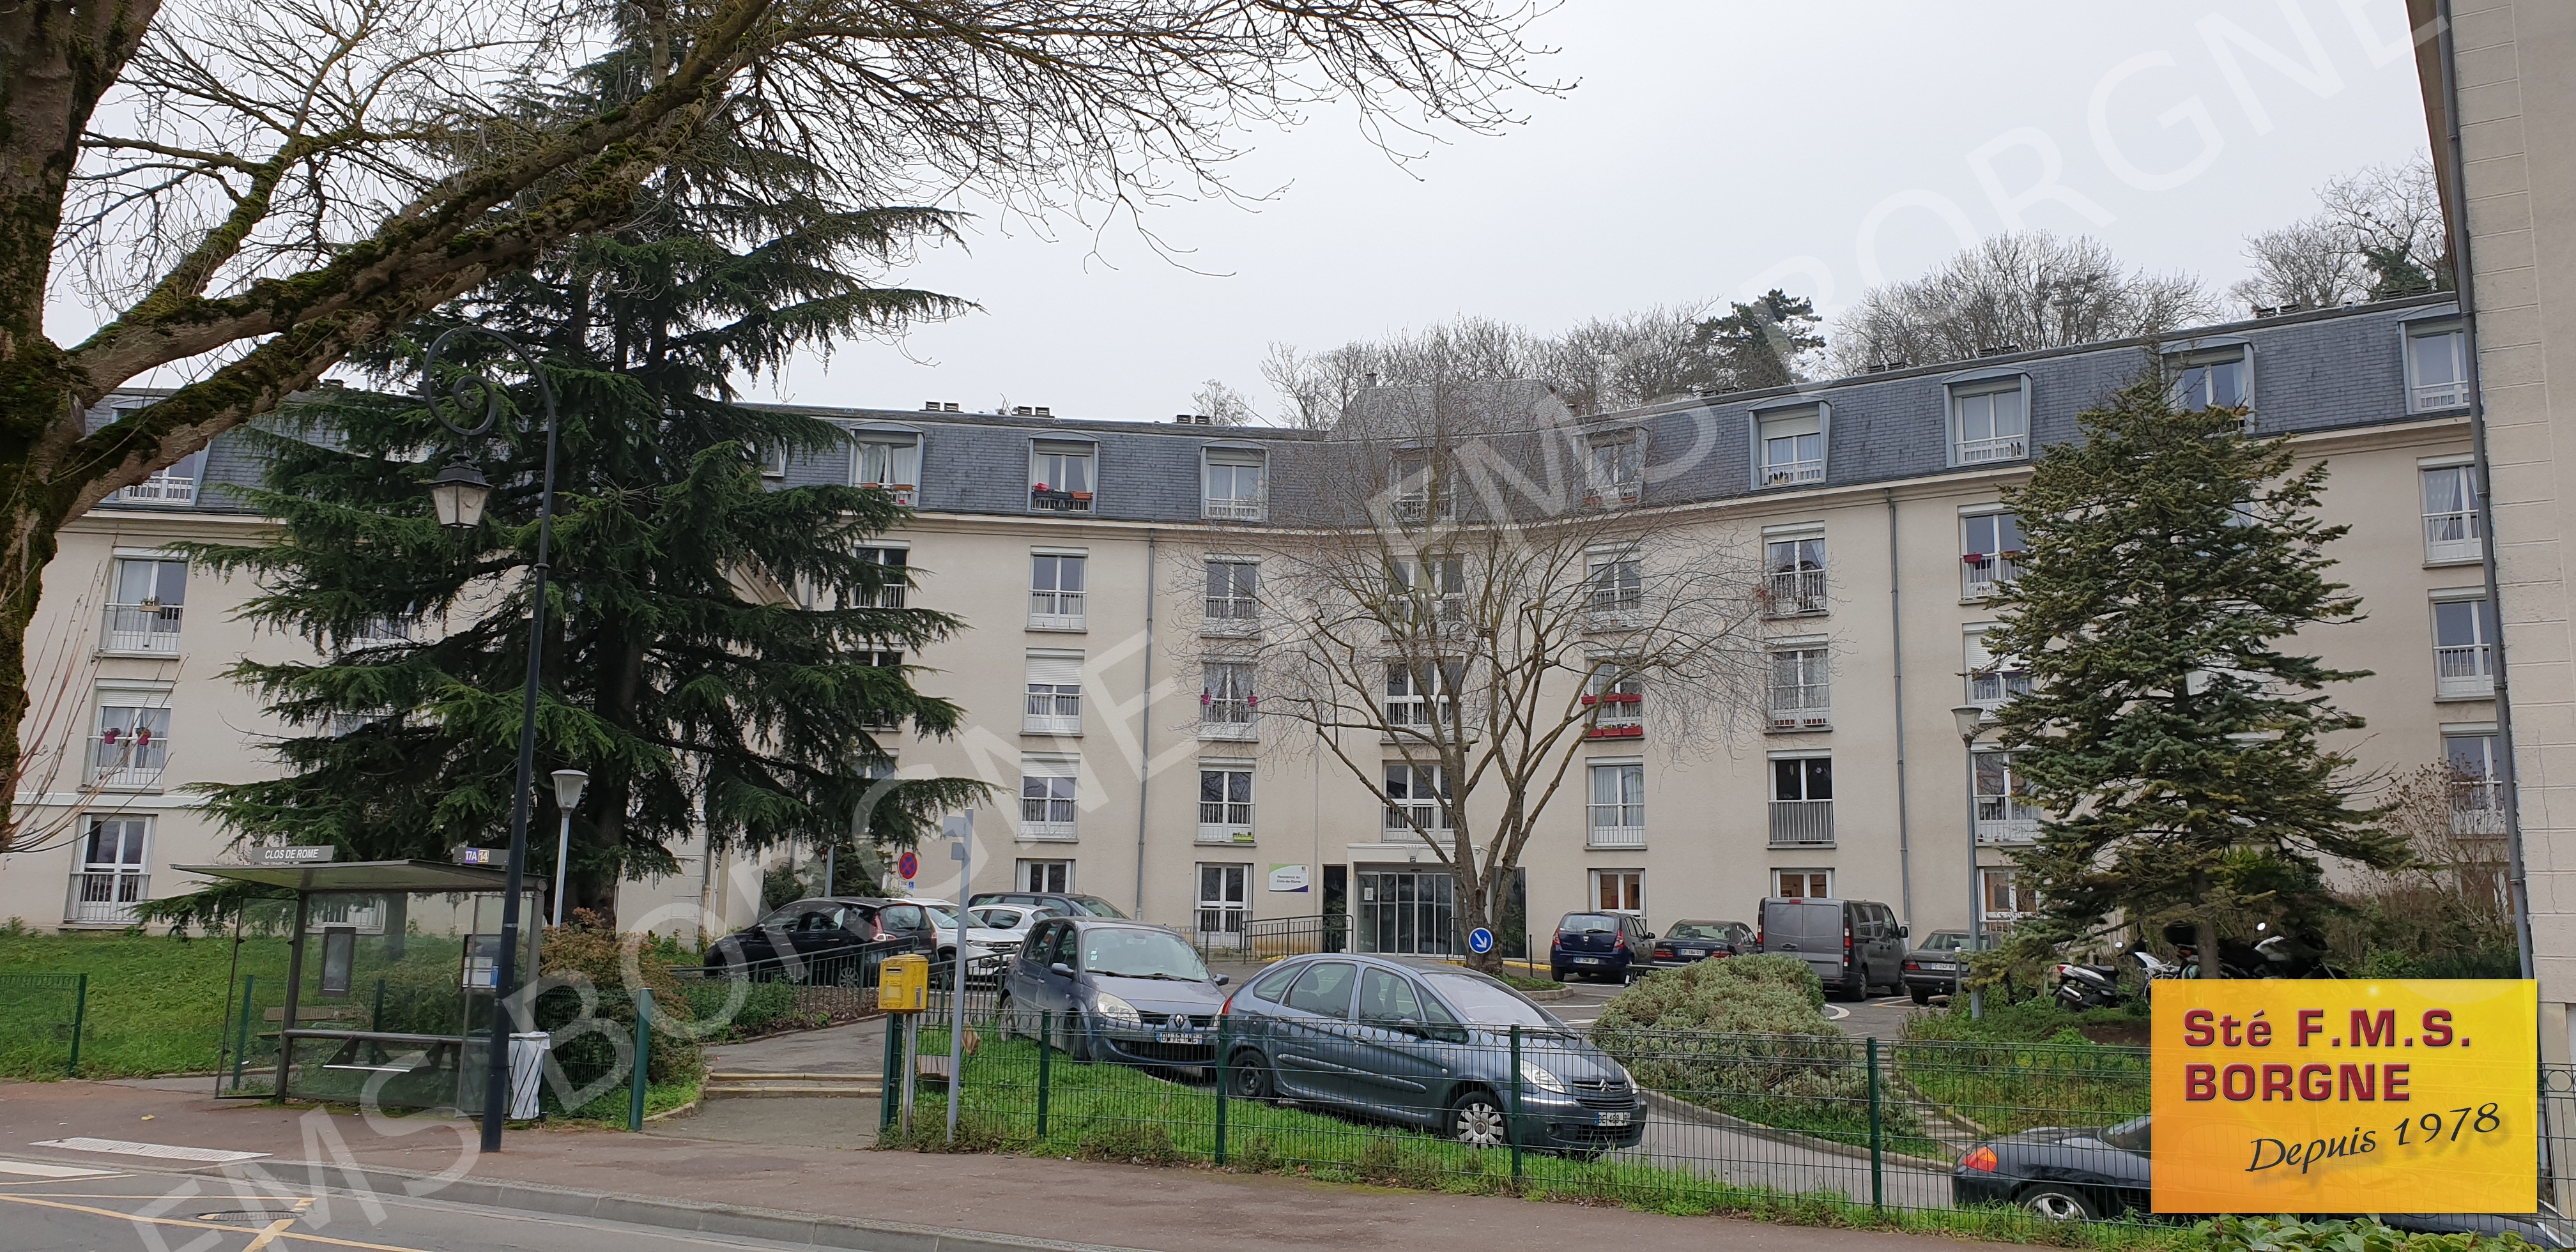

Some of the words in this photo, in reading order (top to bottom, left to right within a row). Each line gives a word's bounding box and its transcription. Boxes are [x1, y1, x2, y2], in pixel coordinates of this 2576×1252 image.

[264, 850, 284, 859] CLOS
[285, 849, 296, 859] DE
[296, 848, 319, 859] ROME
[465, 851, 477, 861] 17A
[480, 851, 489, 861] 14
